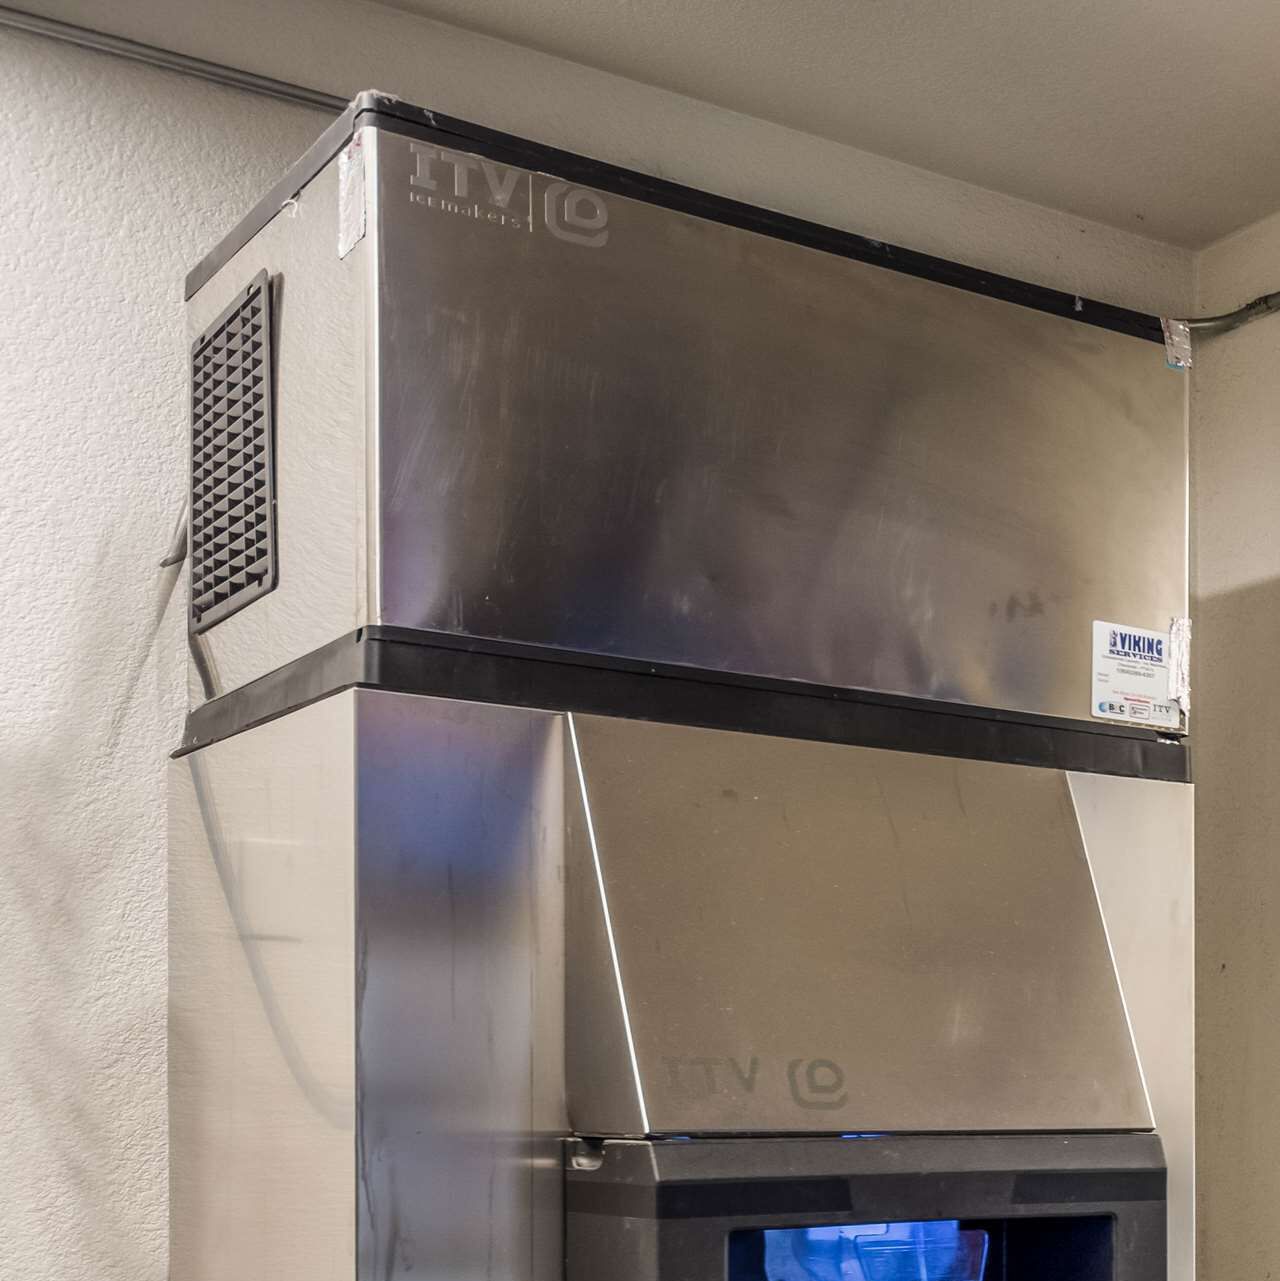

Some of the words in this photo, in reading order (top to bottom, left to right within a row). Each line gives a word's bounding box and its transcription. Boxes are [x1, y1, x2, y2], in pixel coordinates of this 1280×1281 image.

[410, 143, 520, 208] ITV
[1109, 649, 1163, 662] SERVICES
[1119, 632, 1163, 656] VIKING
